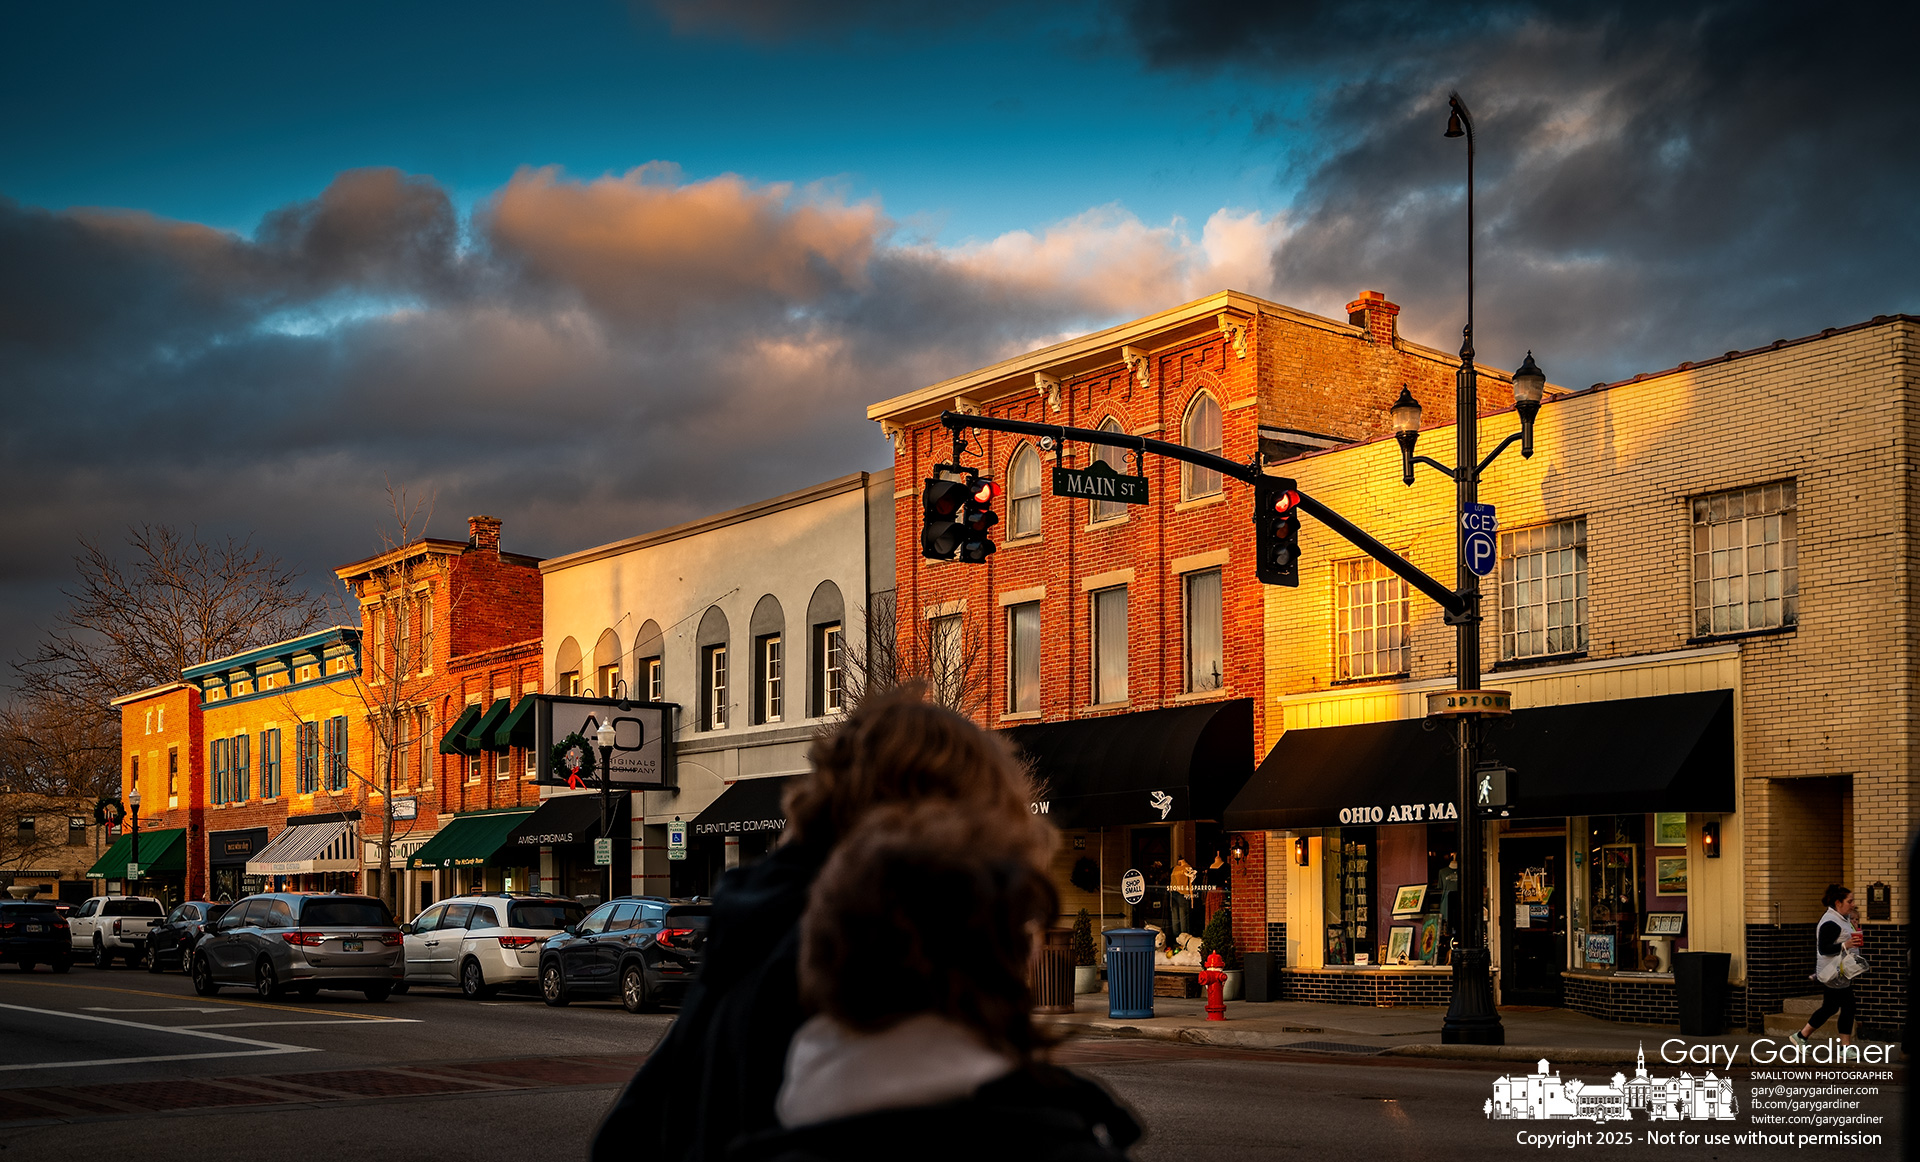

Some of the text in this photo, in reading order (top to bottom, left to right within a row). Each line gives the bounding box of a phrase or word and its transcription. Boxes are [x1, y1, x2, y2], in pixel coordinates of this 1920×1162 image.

[1067, 474, 1135, 497] MAIN ST
[1474, 539, 1491, 569] P
[1339, 802, 1458, 824] OHIO ART MA
[696, 818, 787, 834] FURNITURE COMPANY
[518, 832, 573, 845] AMISH ORIGINALS
[1125, 879, 1140, 888] SHOP
[1520, 868, 1547, 888] Art
[1124, 886, 1142, 894] SMALL
